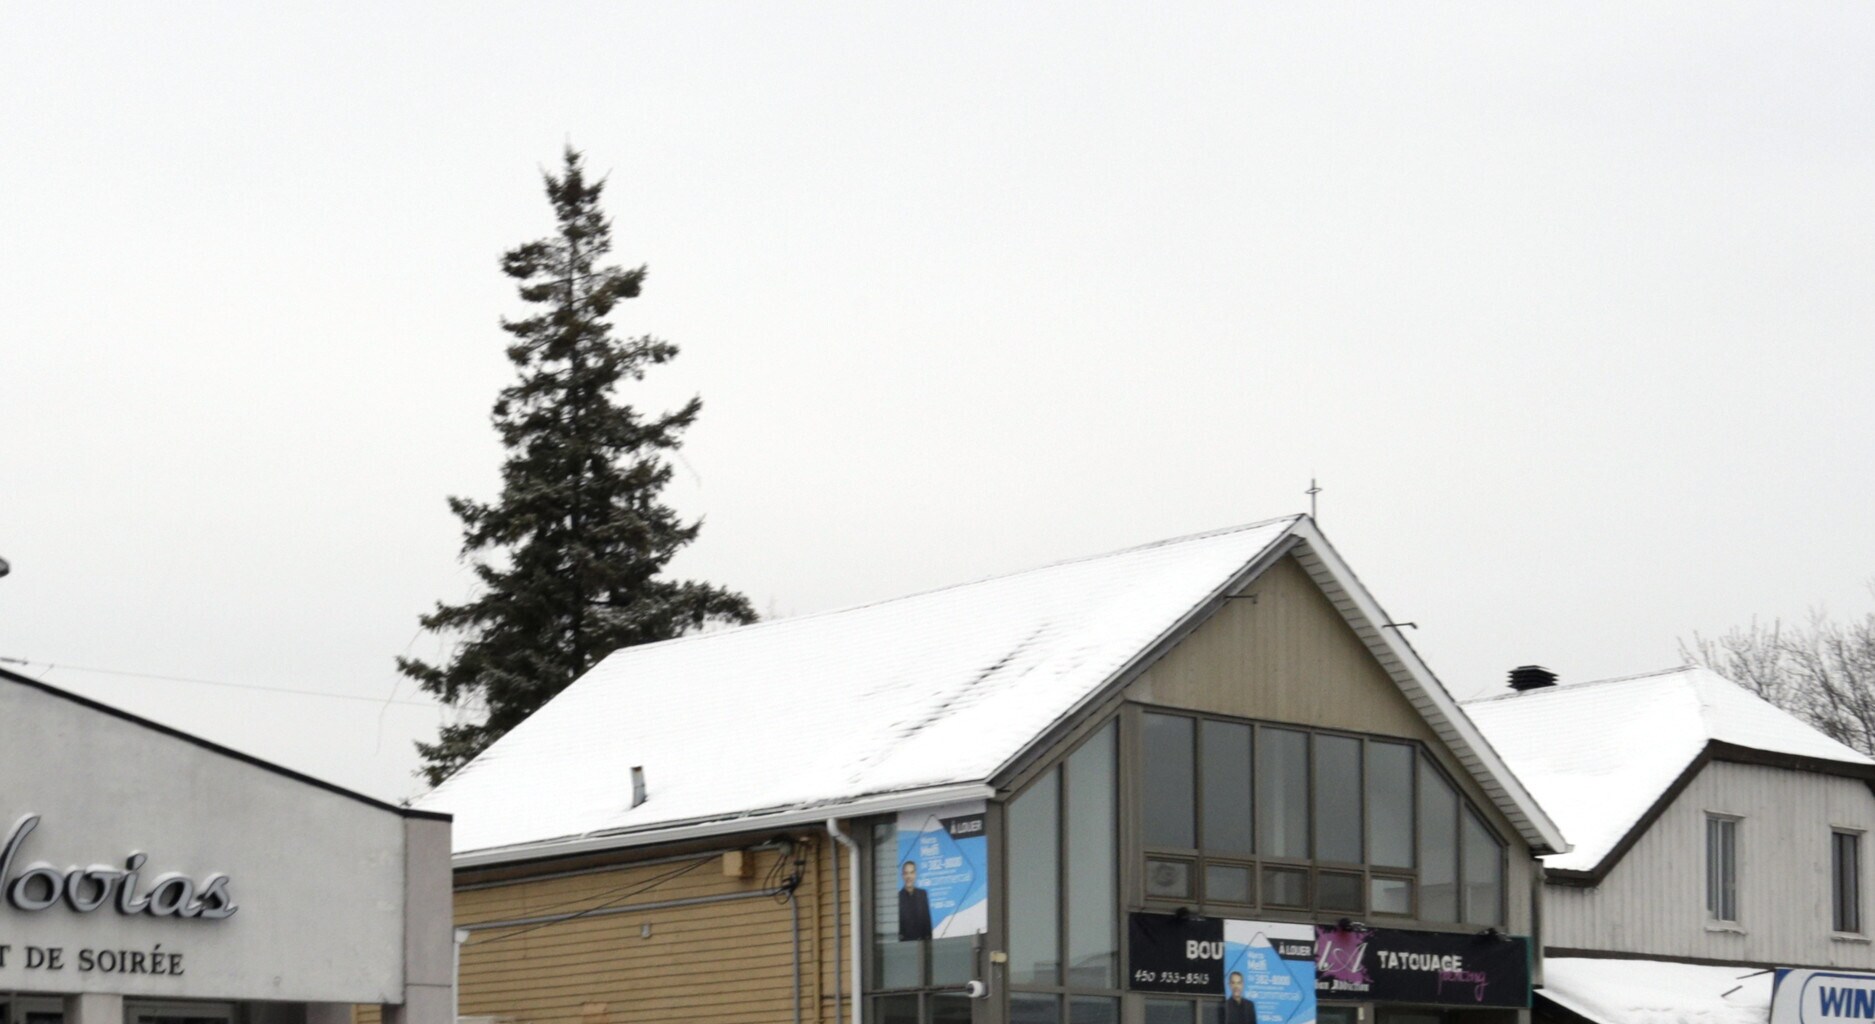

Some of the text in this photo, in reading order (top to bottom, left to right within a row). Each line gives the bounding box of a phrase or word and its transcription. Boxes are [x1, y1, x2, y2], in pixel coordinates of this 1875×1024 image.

[957, 820, 982, 833] LOUER
[1186, 940, 1224, 960] BOU
[1286, 945, 1311, 956] LOUER
[25, 946, 64, 970] DE
[78, 943, 185, 976] SOIRÉE
[1377, 950, 1463, 973] TATOUAGE
[1134, 969, 1156, 982] 450
